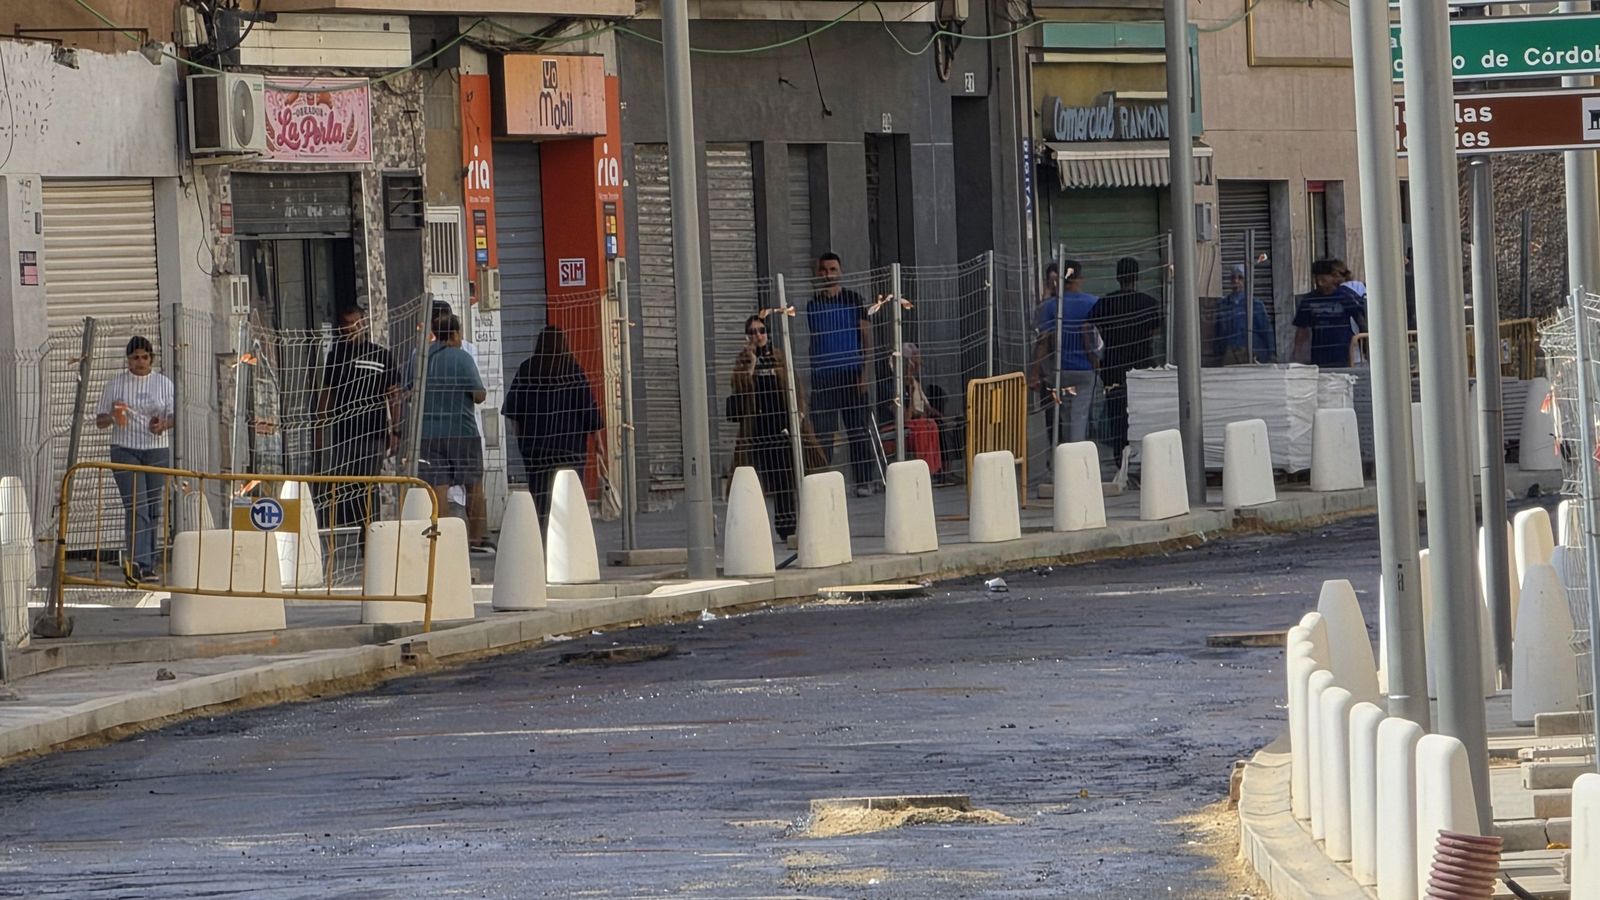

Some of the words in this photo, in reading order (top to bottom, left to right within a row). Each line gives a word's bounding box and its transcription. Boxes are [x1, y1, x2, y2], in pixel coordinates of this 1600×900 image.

[1481, 49, 1509, 68] de
[277, 108, 301, 151] La
[1054, 95, 1115, 140] Comercial
[467, 144, 490, 190] ria
[598, 142, 619, 187] ria
[561, 263, 584, 282] SIM
